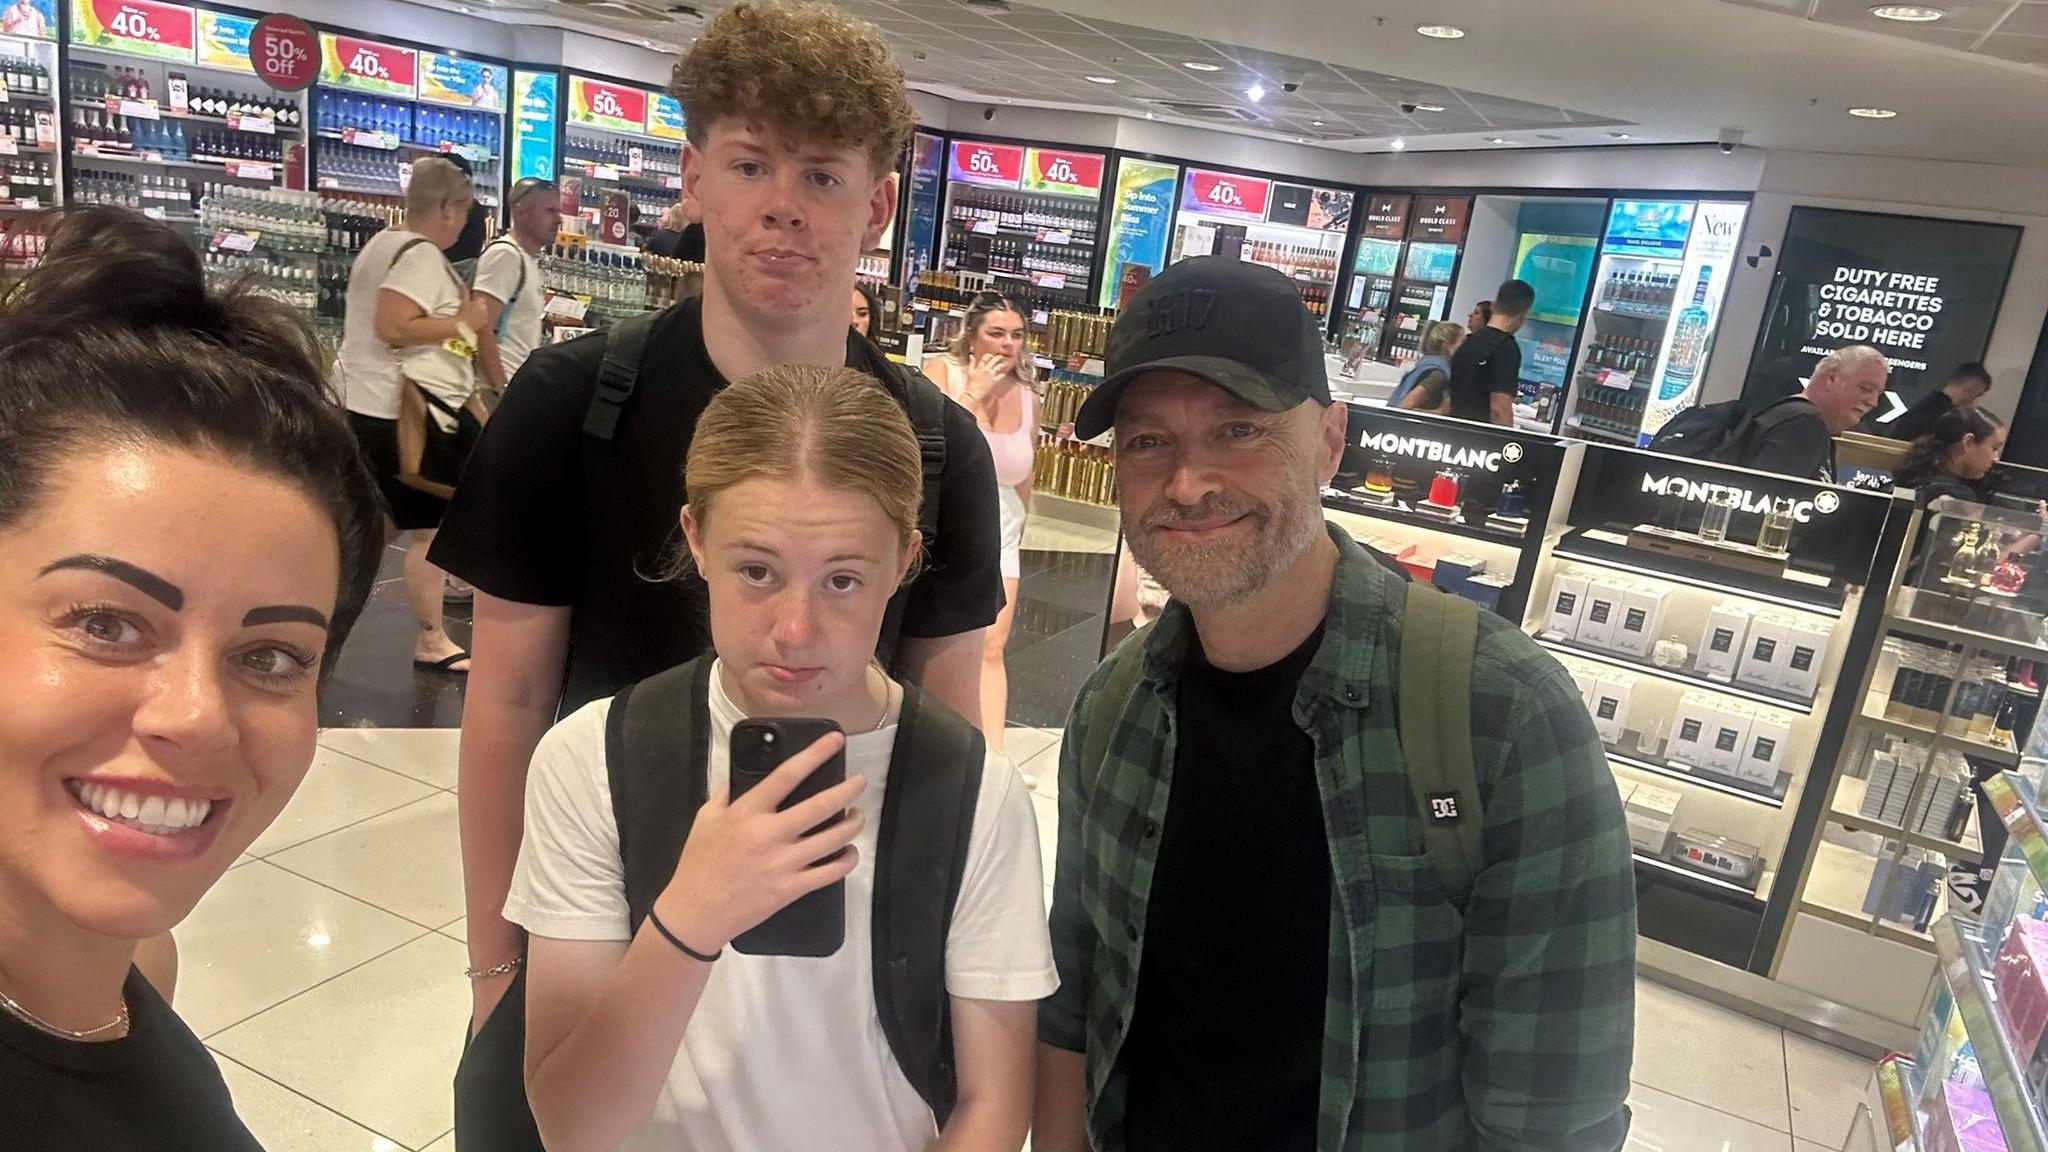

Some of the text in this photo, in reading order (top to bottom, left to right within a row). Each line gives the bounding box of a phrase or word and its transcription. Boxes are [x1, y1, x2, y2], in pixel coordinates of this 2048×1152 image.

[110, 11, 161, 40] 40%
[265, 35, 308, 61] 50%
[265, 57, 296, 75] Off
[349, 53, 390, 78] 40%
[593, 93, 624, 117] 50%
[969, 153, 1000, 174] 50%
[1046, 160, 1079, 183] 40%
[1138, 191, 1157, 203] into
[1207, 183, 1243, 206] 40%
[1122, 201, 1160, 215] Summer
[1438, 217, 1457, 225] CLASS
[1703, 213, 1737, 237] New
[1834, 266, 1939, 293] DUTY FREE
[1819, 283, 1943, 313] CIGARETTES
[1817, 302, 1934, 331] & TOBACCO
[1815, 320, 1926, 349] SOLD HERE
[1359, 429, 1502, 472] MONTBLANC
